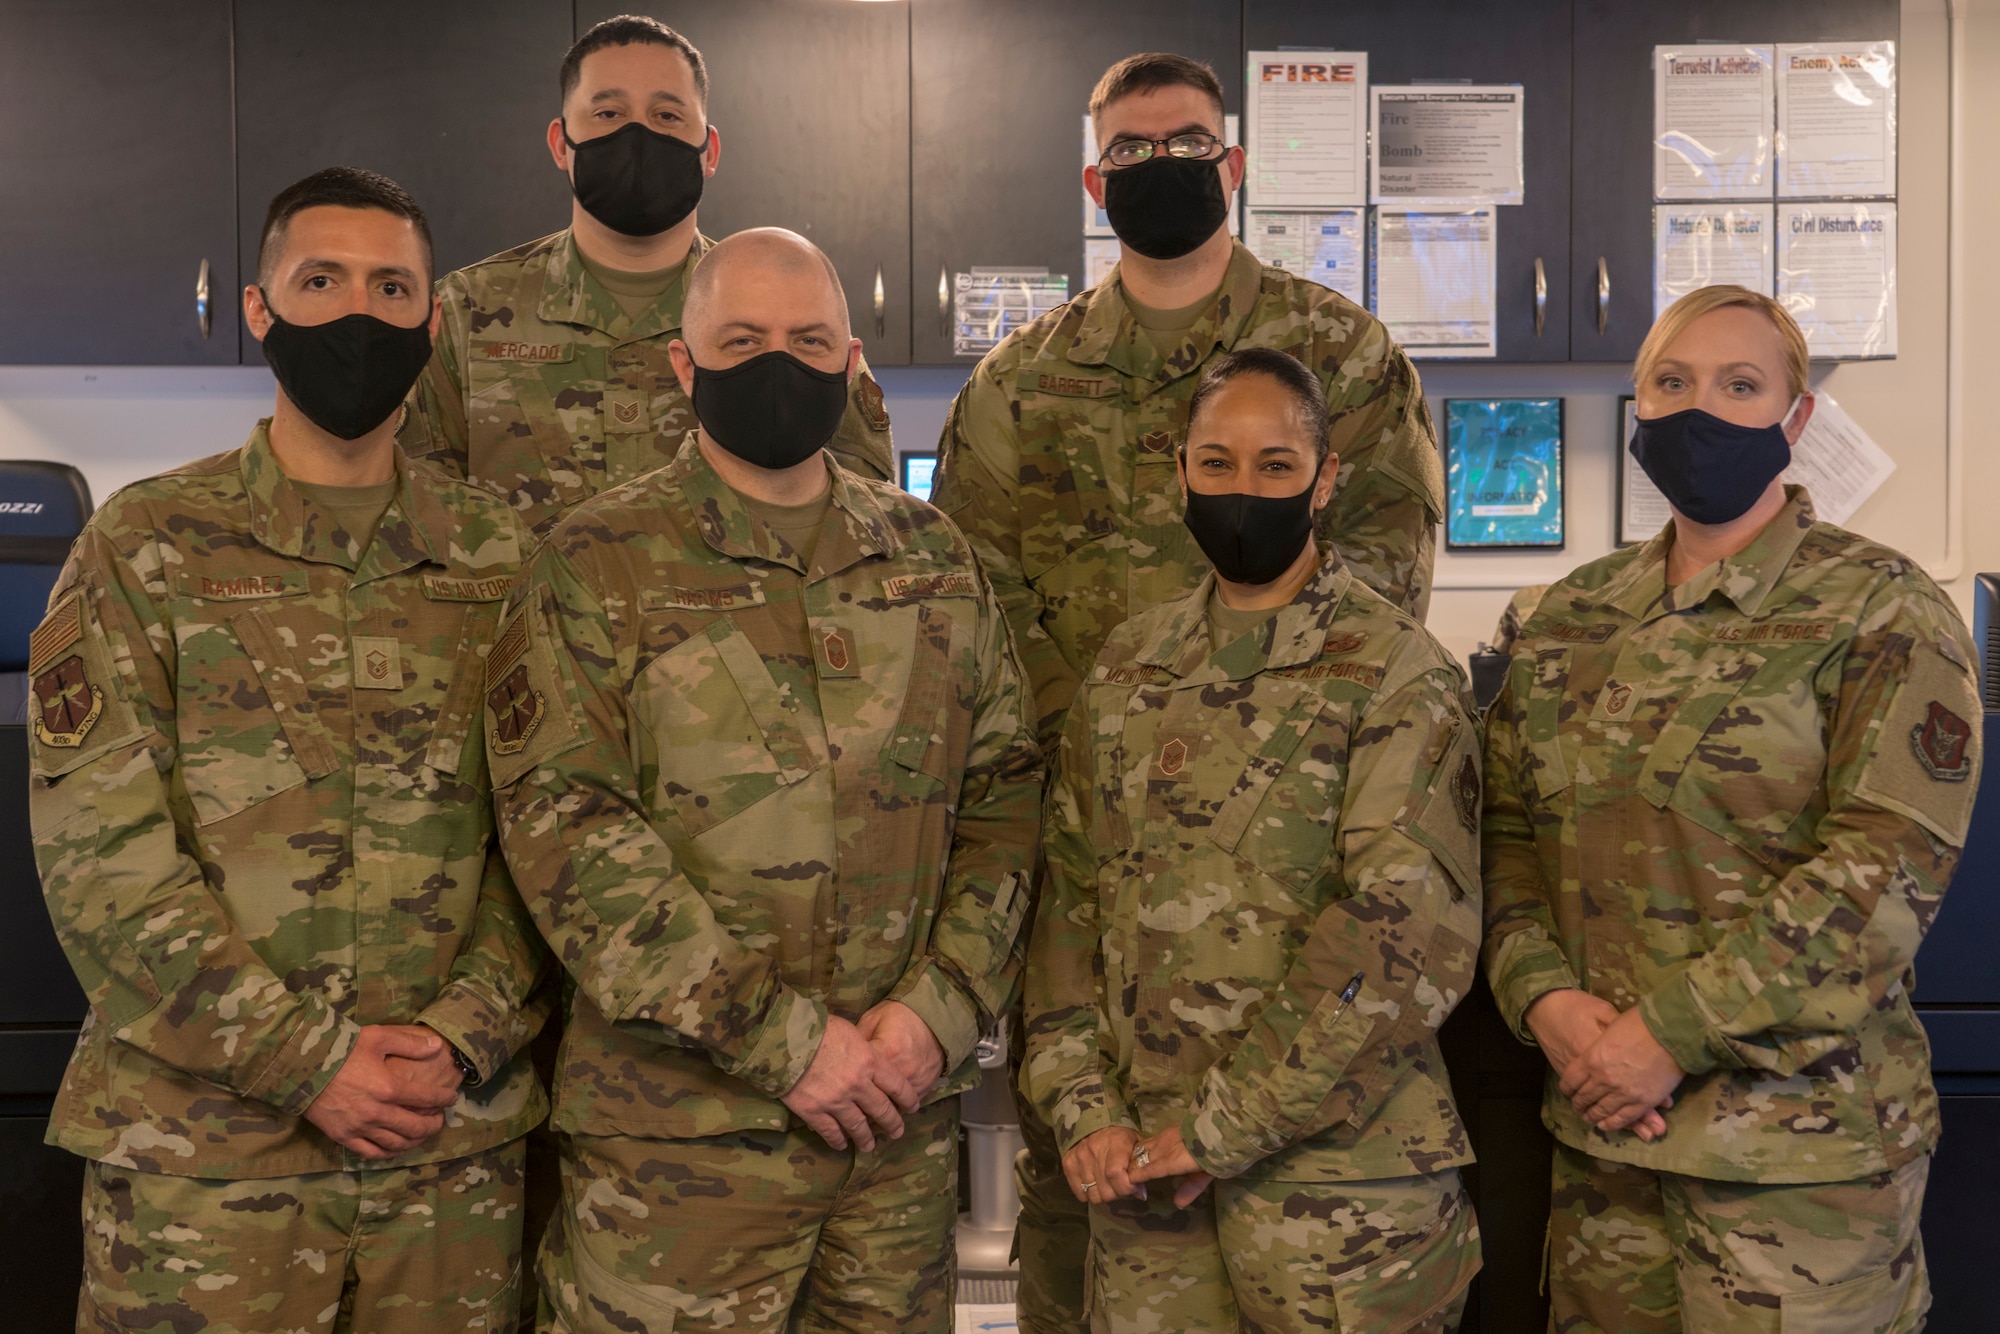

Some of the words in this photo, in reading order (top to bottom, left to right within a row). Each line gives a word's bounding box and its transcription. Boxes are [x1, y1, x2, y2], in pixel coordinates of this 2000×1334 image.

[1669, 57, 1712, 75] Terrorist
[1715, 56, 1761, 75] Activities
[1790, 55, 1834, 72] Enemy
[1262, 64, 1355, 82] FIRE
[1381, 112, 1410, 126] Fire
[1381, 144, 1423, 158] Bomb
[1380, 173, 1412, 182] Natural
[1380, 184, 1417, 194] Disaster
[487, 342, 560, 360] MERCADO
[1038, 374, 1104, 396] GARRETT
[1493, 459, 1516, 470] ACT
[201, 575, 285, 597] RAMIREZ
[455, 581, 480, 599] AIR
[933, 575, 974, 596] FORCE
[673, 587, 735, 607] HARMS
[1716, 624, 1741, 641] U.S.
[1744, 623, 1771, 640] AIR
[1771, 623, 1825, 640] FORCE
[1300, 665, 1325, 680] AIR
[1326, 663, 1377, 686] FORCE
[77, 711, 98, 736] WING
